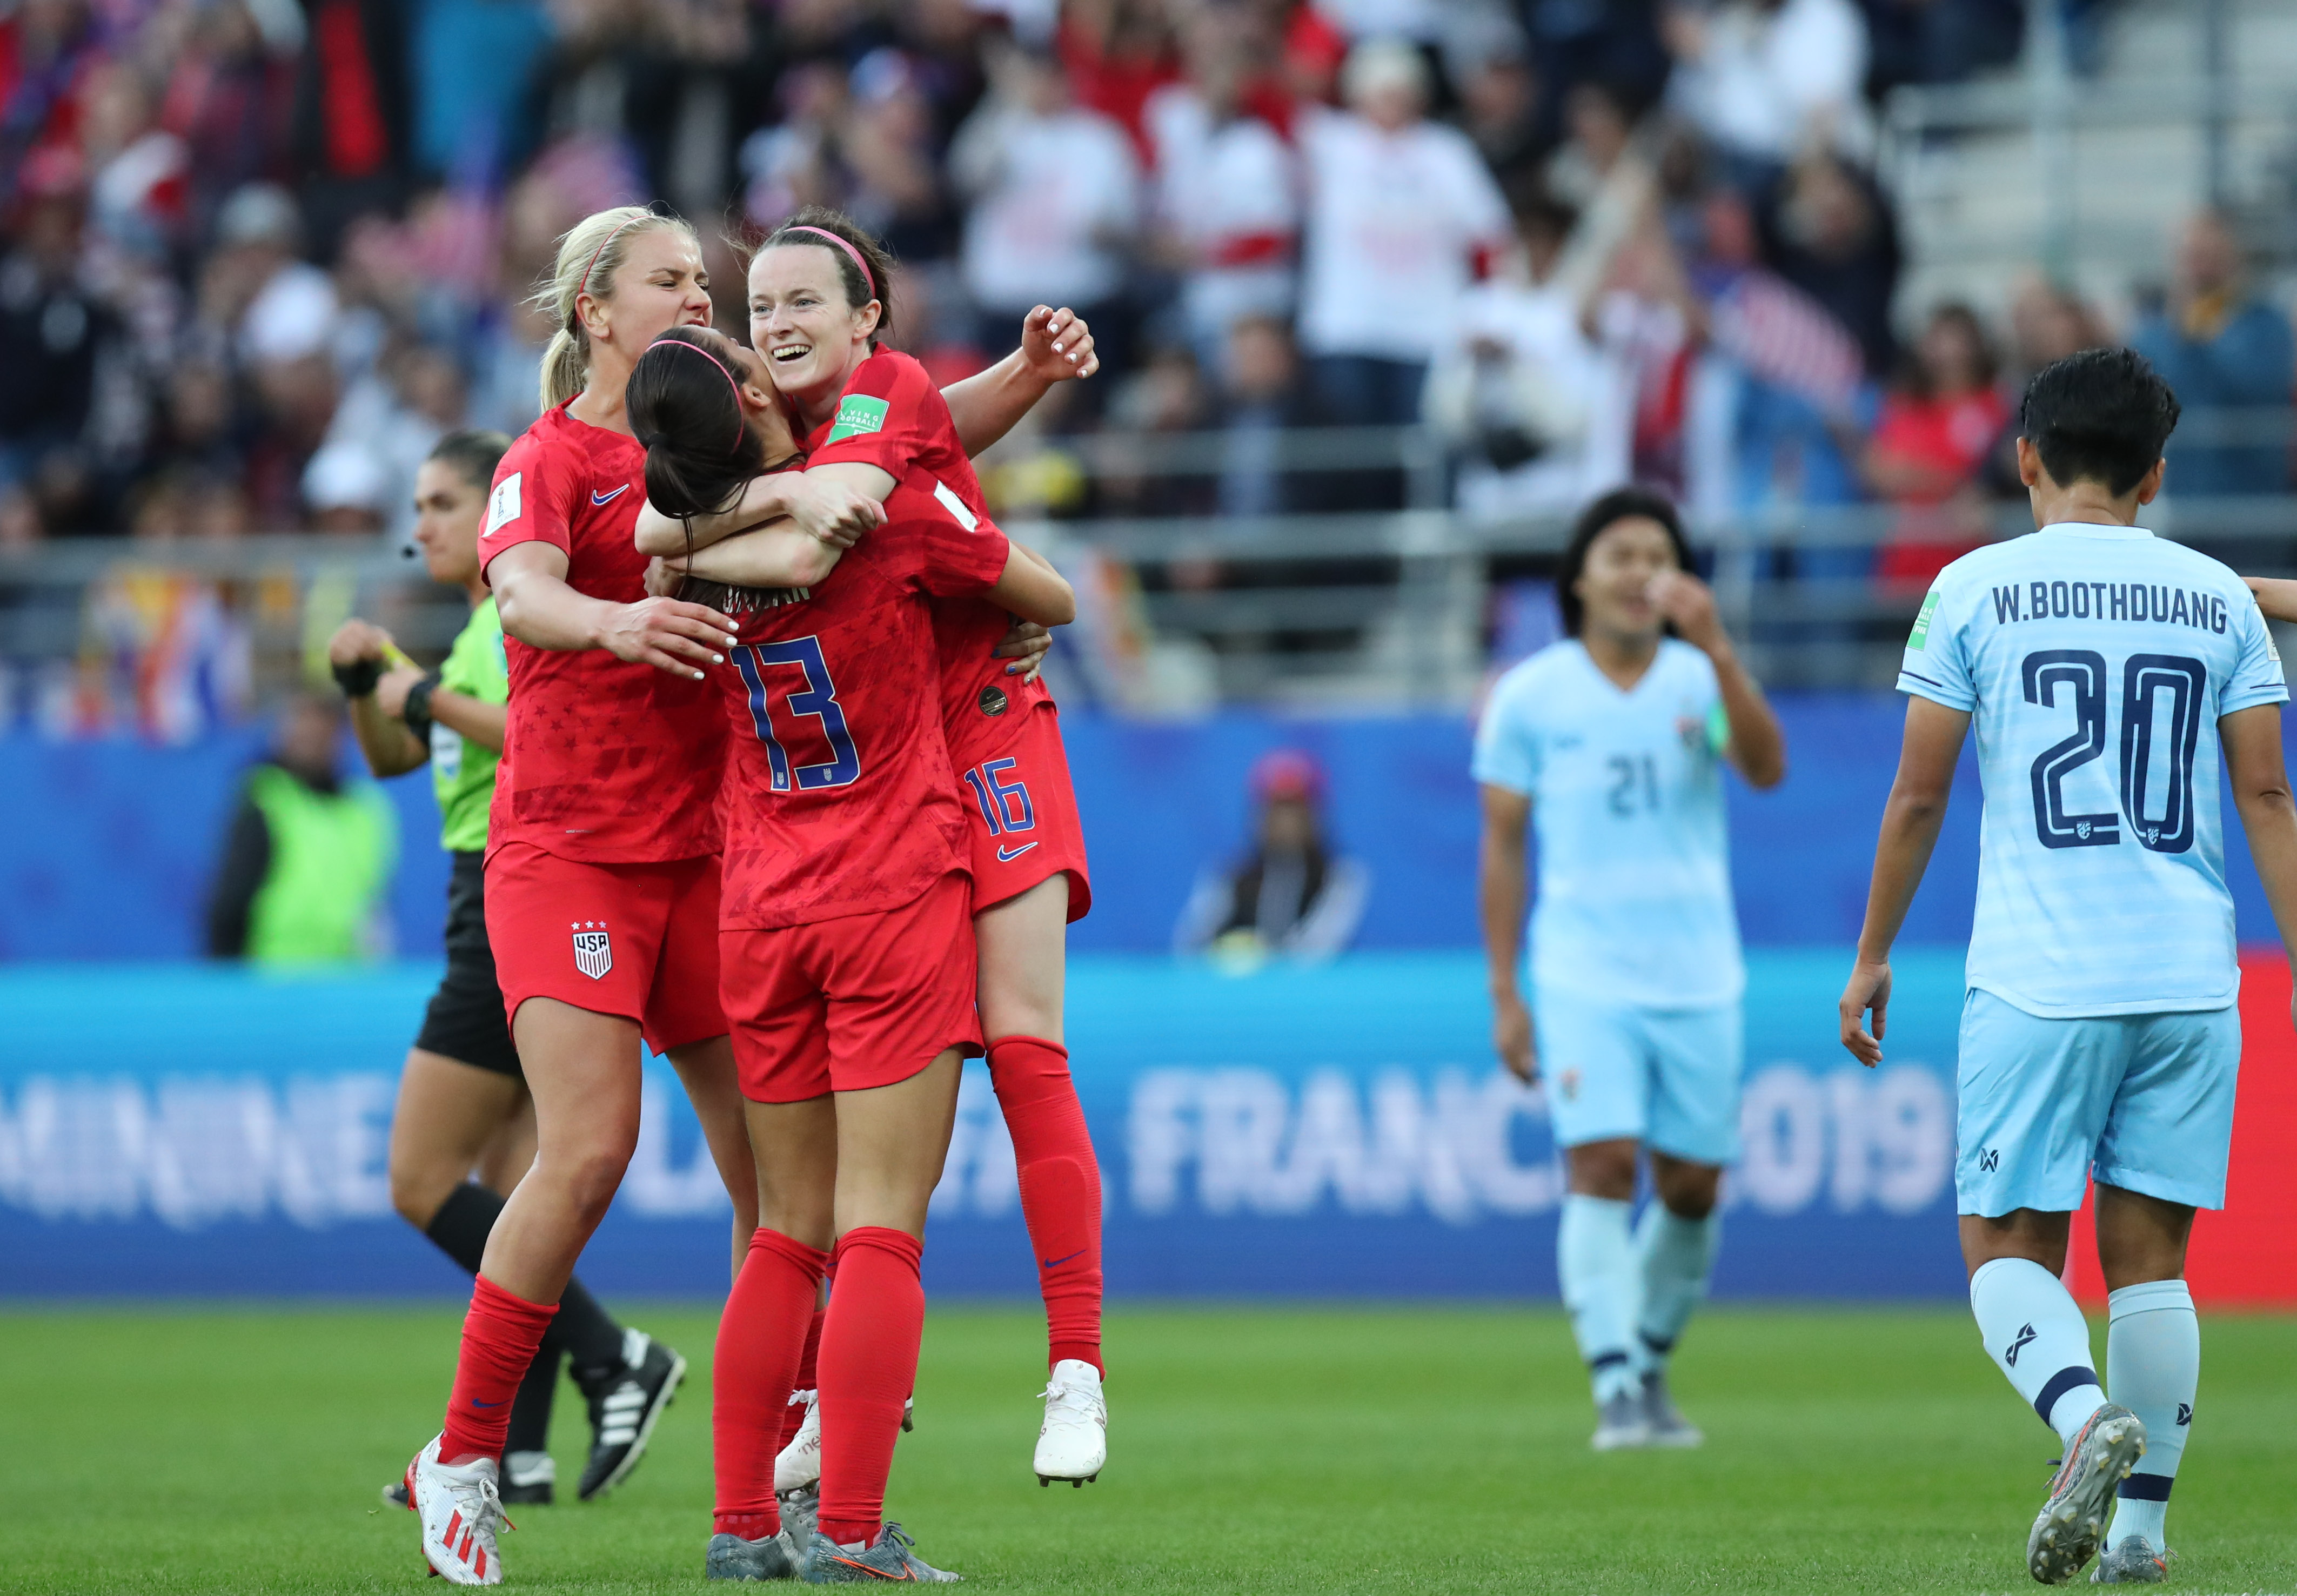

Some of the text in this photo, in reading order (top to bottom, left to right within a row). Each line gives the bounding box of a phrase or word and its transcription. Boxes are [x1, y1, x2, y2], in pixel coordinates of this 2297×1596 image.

[1914, 625, 1927, 635] FIFA
[1992, 580, 2227, 635] W.BOOTHDUANG
[729, 635, 860, 792] 13
[1606, 754, 1661, 819] 21
[2021, 649, 2206, 854] 20
[965, 757, 1035, 836] 16
[576, 935, 607, 952] USA
[1718, 1062, 1950, 1217] 019
